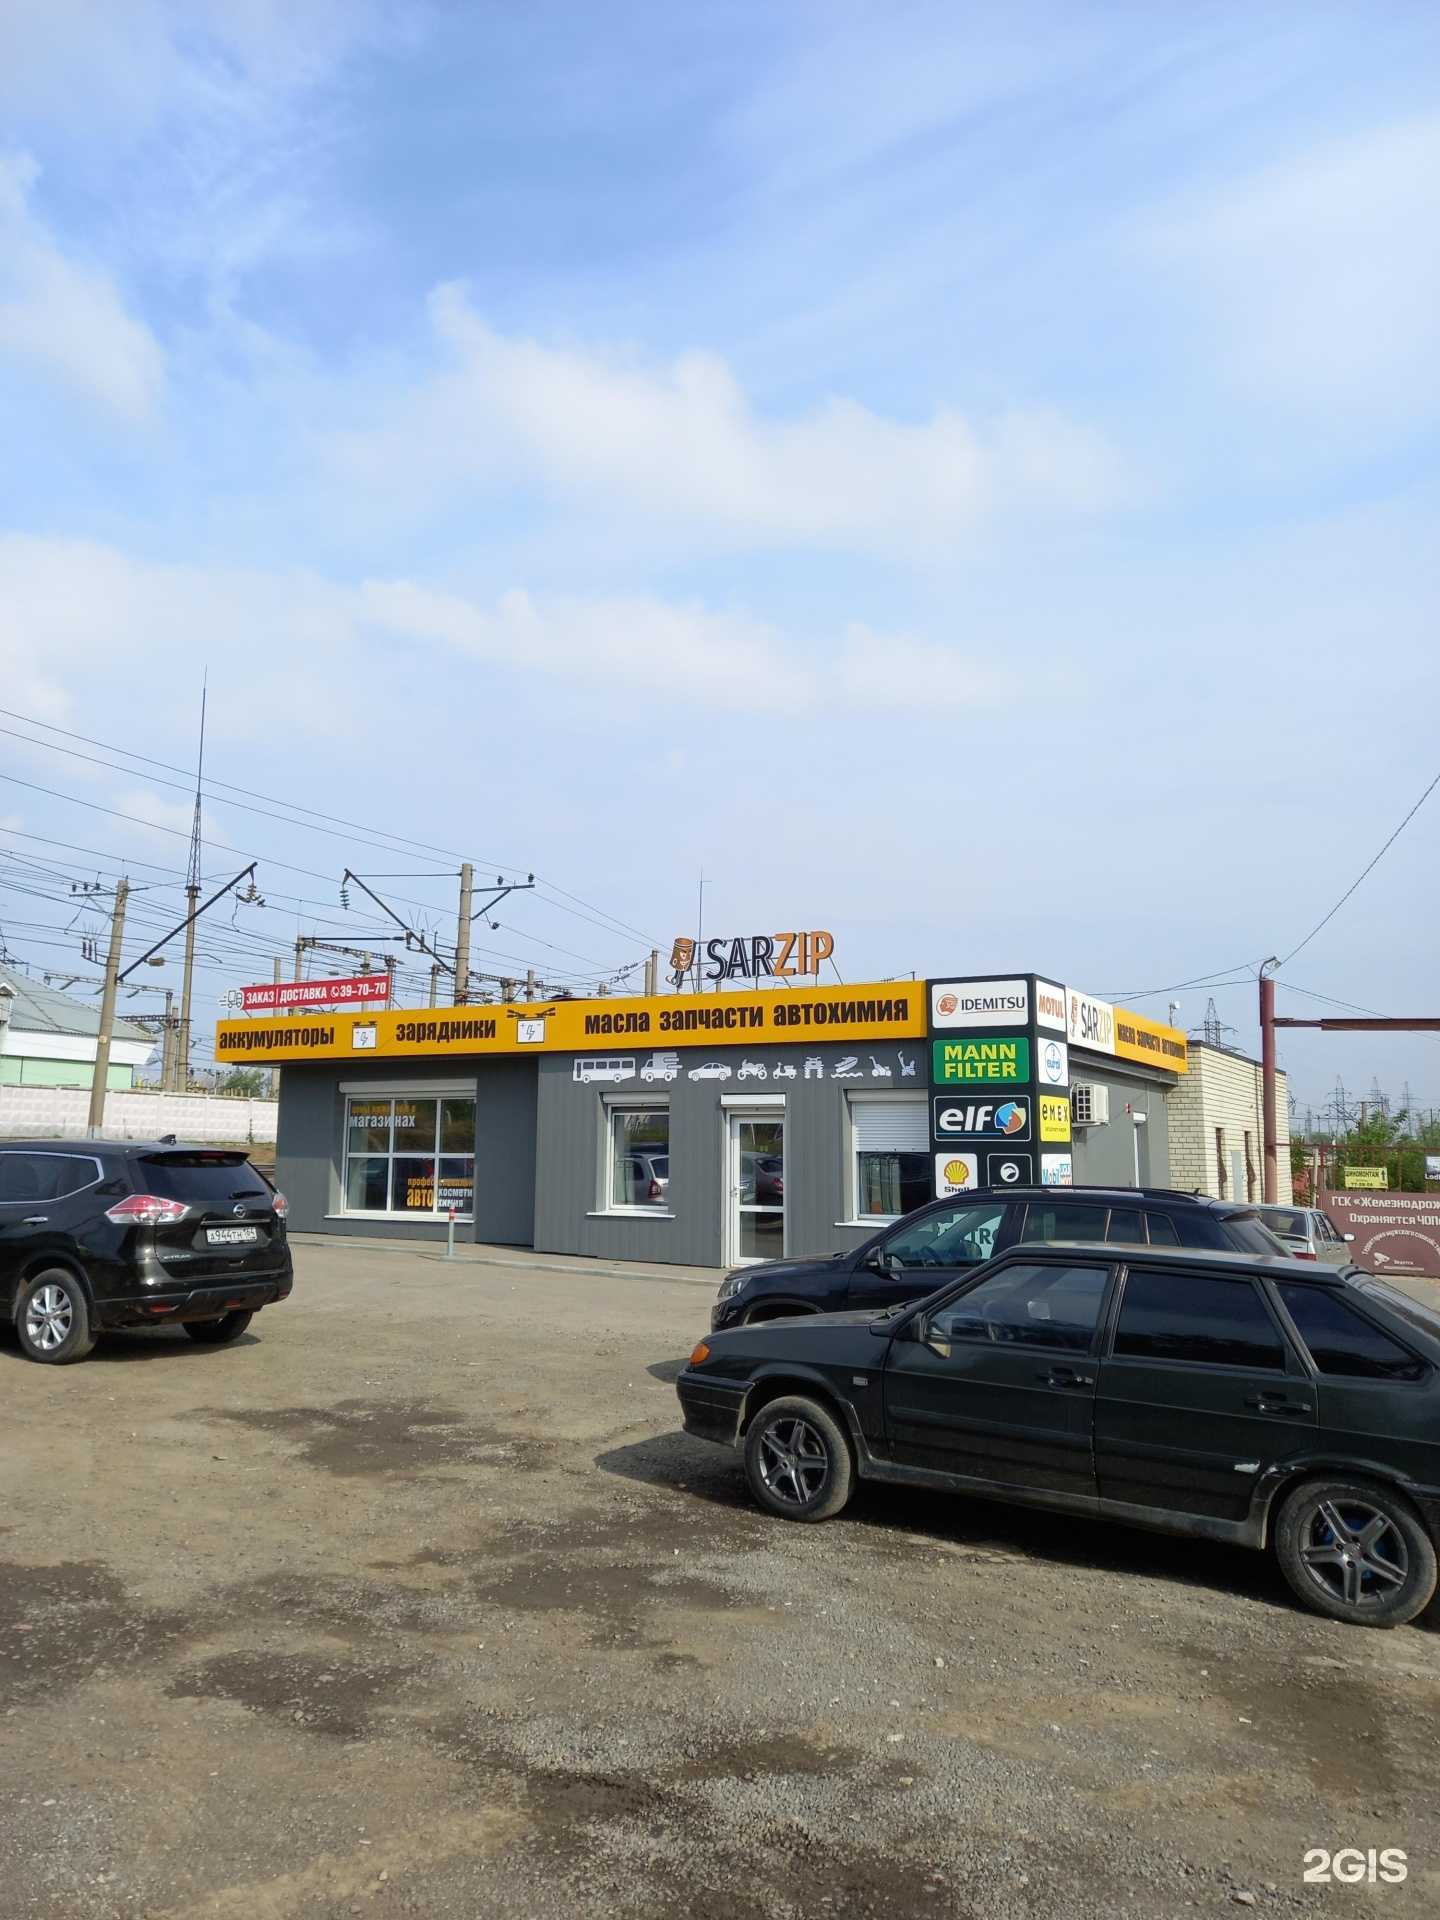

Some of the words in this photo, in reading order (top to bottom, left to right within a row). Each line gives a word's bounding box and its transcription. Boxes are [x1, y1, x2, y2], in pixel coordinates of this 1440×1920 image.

[706, 931, 834, 980] SARZIP
[246, 990, 275, 1004] ЗАКАЗ
[279, 988, 328, 1003] ДОСТАВКА
[340, 982, 387, 997] 39-70-70
[961, 996, 1025, 1011] IDEMITSU
[585, 1012, 650, 1034] масла
[659, 1006, 764, 1031] запчасти
[773, 999, 908, 1026] автохимия
[1039, 994, 1064, 1019] MOTUL
[219, 1027, 335, 1050] аккумуляторы
[396, 1019, 496, 1043] зарядники
[944, 1044, 1016, 1060] MANN
[945, 1062, 1017, 1078] FILTER
[939, 1105, 993, 1131] elf
[406, 1188, 434, 1207] авто
[1331, 1196, 1351, 1206] ГСК
[1349, 1213, 1416, 1224] Охраняется
